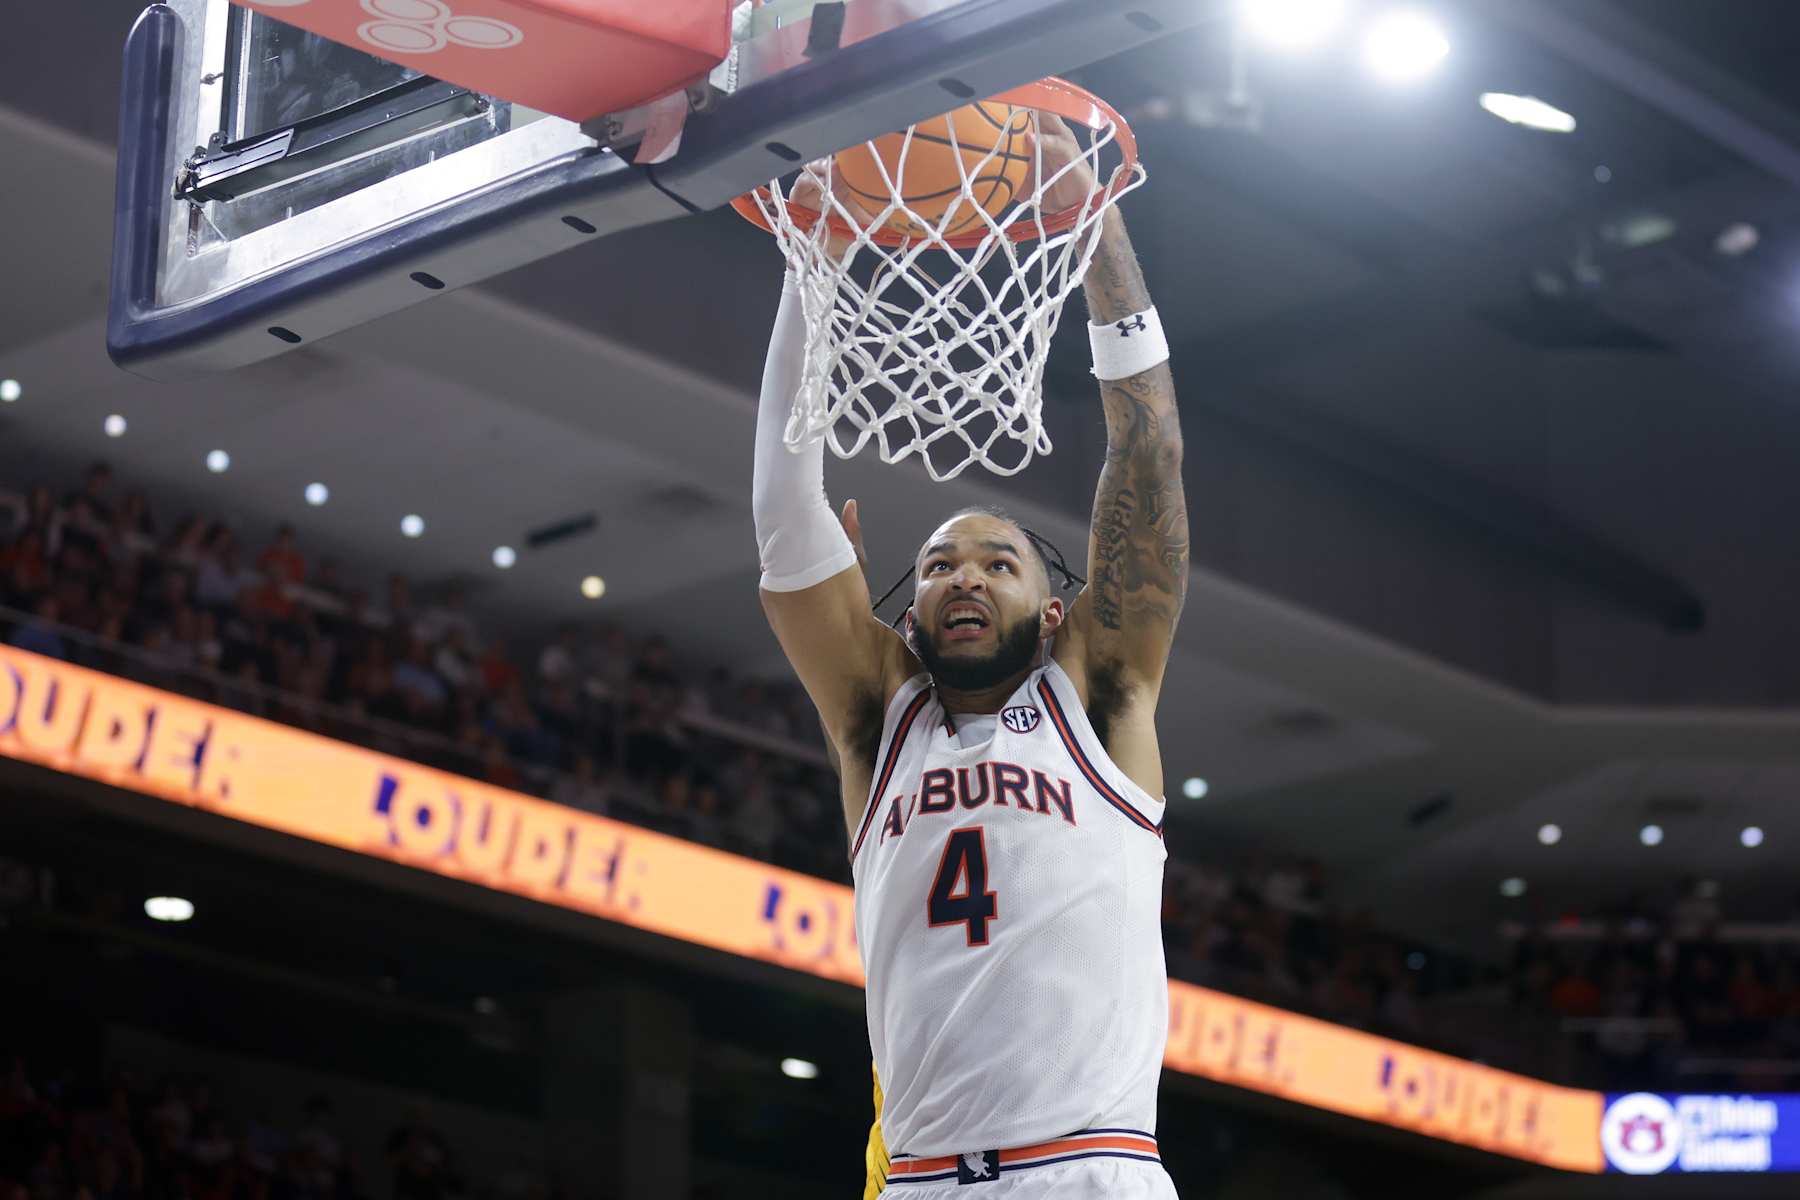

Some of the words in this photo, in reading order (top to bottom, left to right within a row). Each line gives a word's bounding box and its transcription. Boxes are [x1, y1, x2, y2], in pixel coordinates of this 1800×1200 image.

[1003, 706, 1039, 731] SEC
[927, 825, 998, 947] 4
[1370, 1046, 1560, 1158] LOUDE
